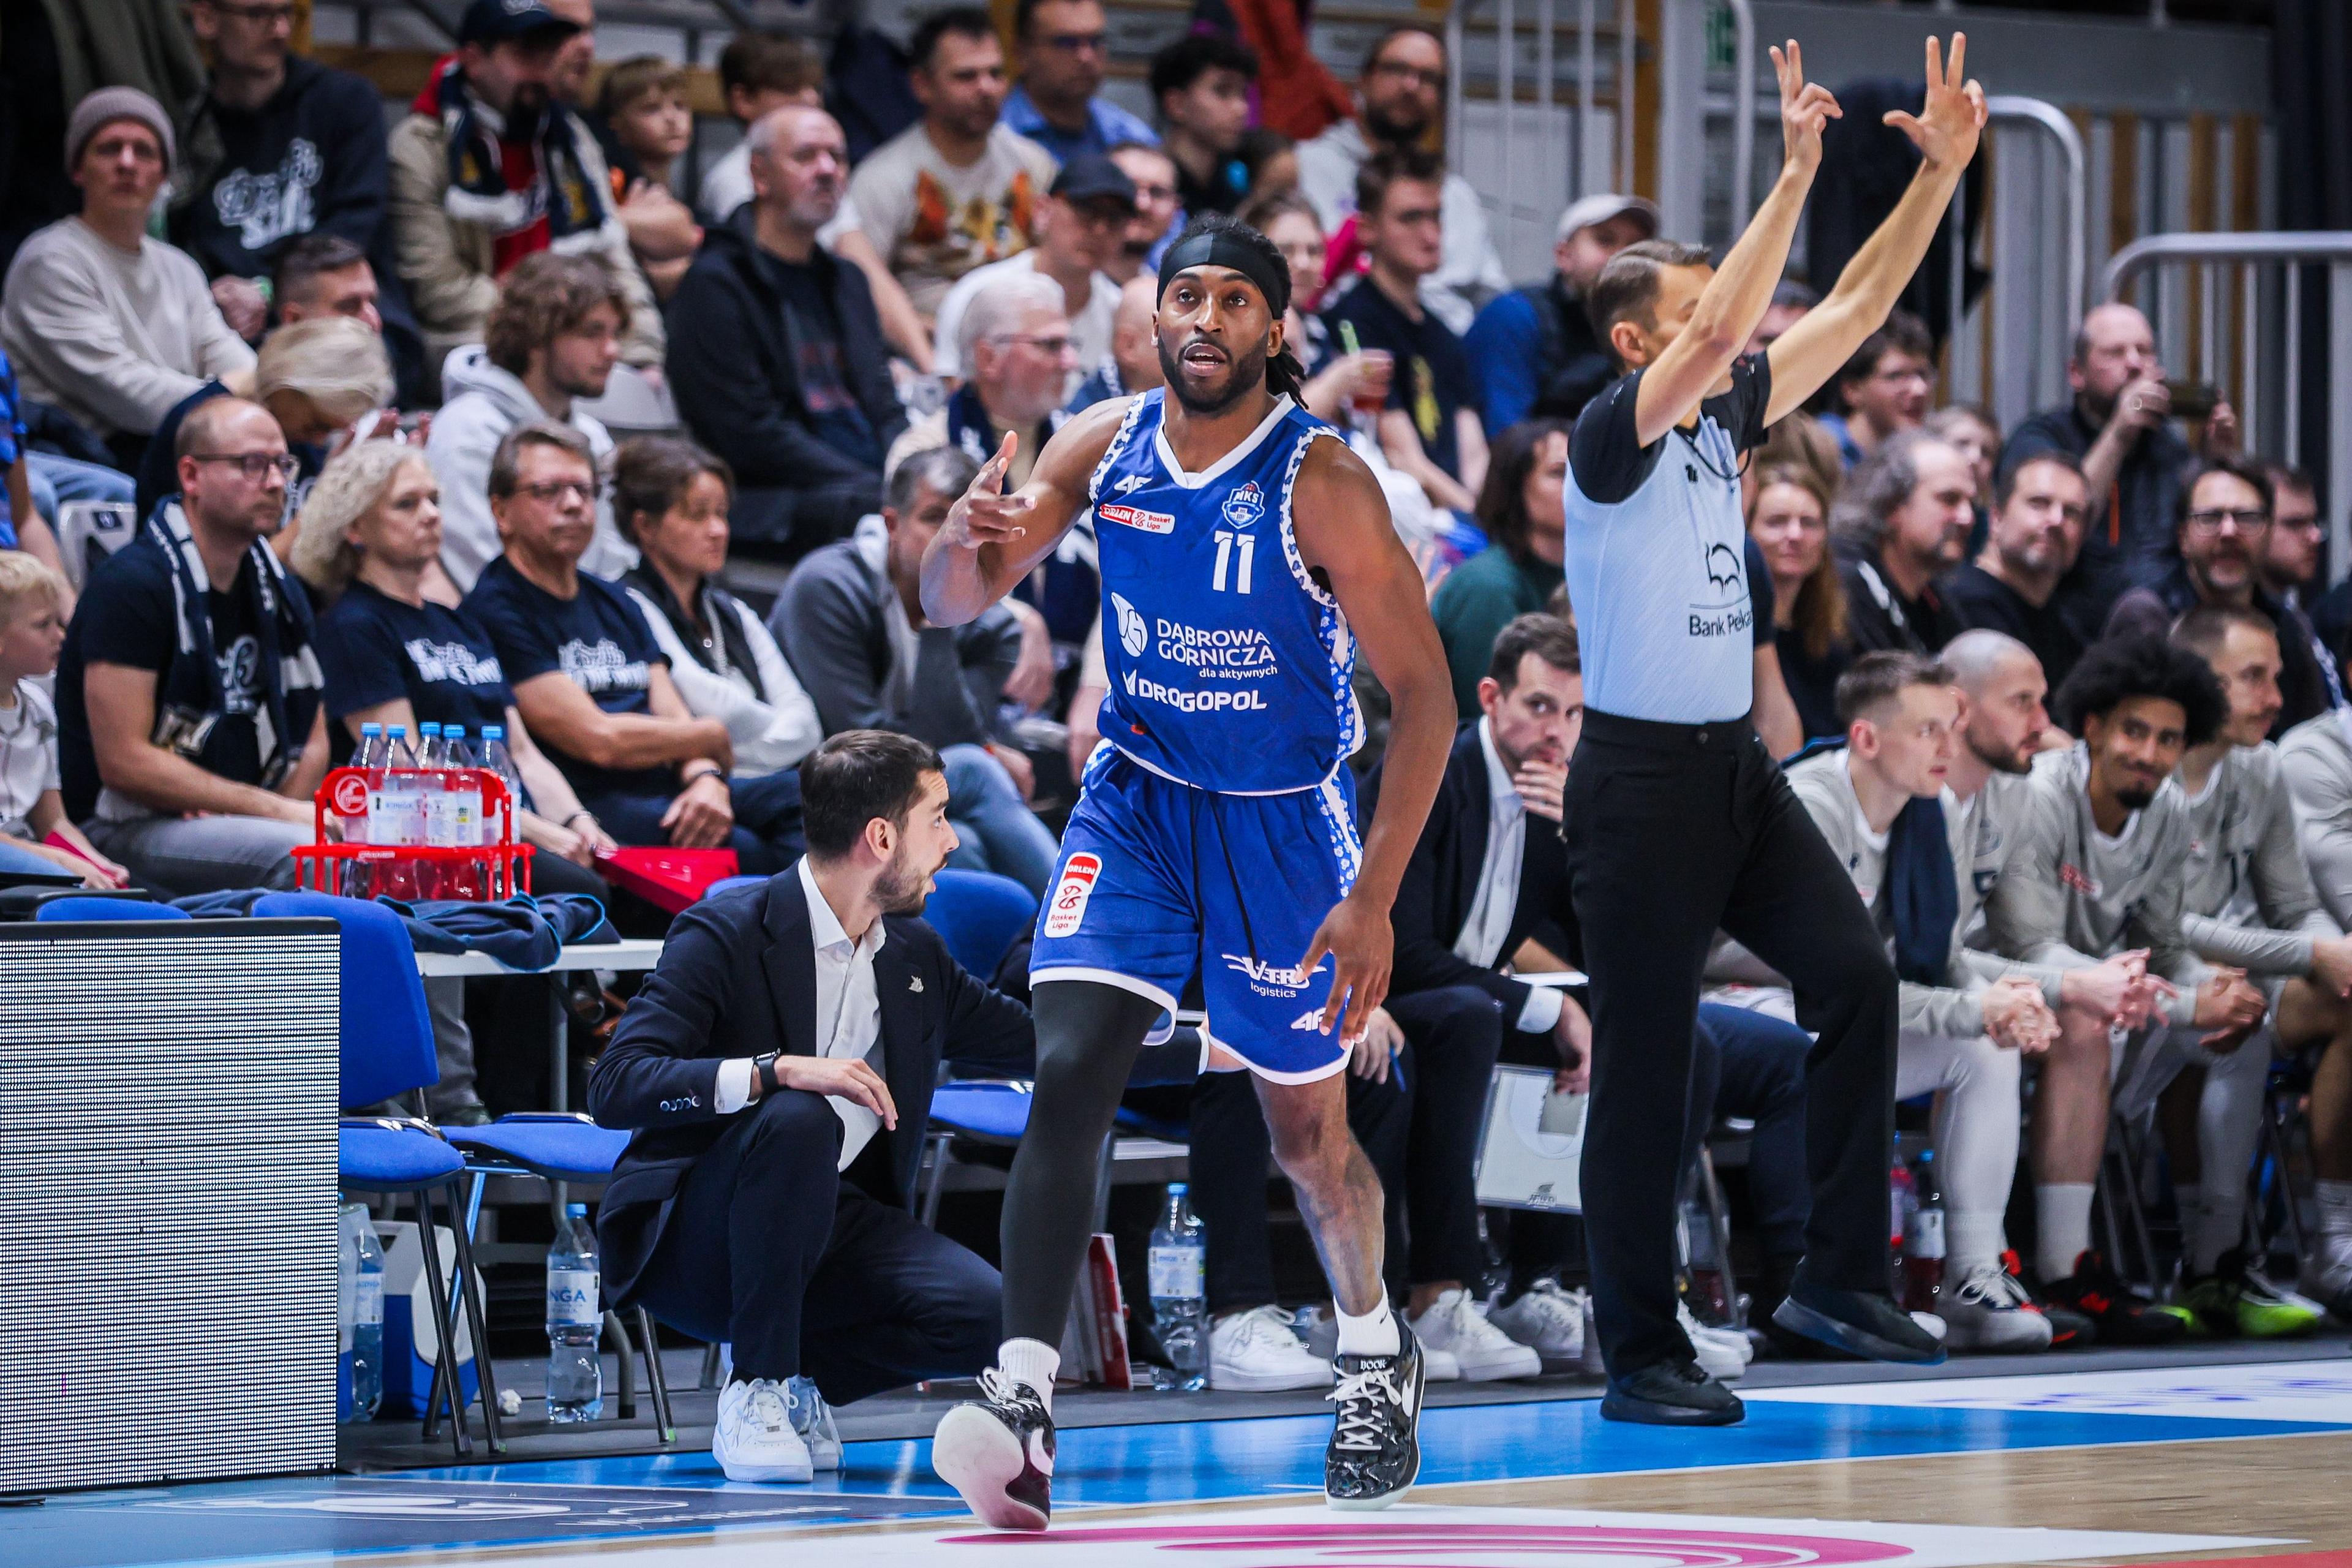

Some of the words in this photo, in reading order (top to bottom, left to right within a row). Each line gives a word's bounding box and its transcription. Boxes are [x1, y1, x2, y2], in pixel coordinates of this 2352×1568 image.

[1234, 491, 1259, 504] MKS
[1104, 508, 1132, 521] ORLEN
[1213, 530, 1255, 594] 11
[1157, 619, 1270, 647] DĄBROWA
[1690, 614, 1726, 636] Bank
[1158, 639, 1275, 666] GÓRNICZA
[1199, 668, 1216, 677] dla
[1219, 665, 1277, 680] aktywnych
[1139, 678, 1267, 712] DROGOPOL
[1068, 865, 1095, 875] ORLEN
[1251, 981, 1296, 998] logistics
[1360, 1359, 1387, 1371] BOOK
